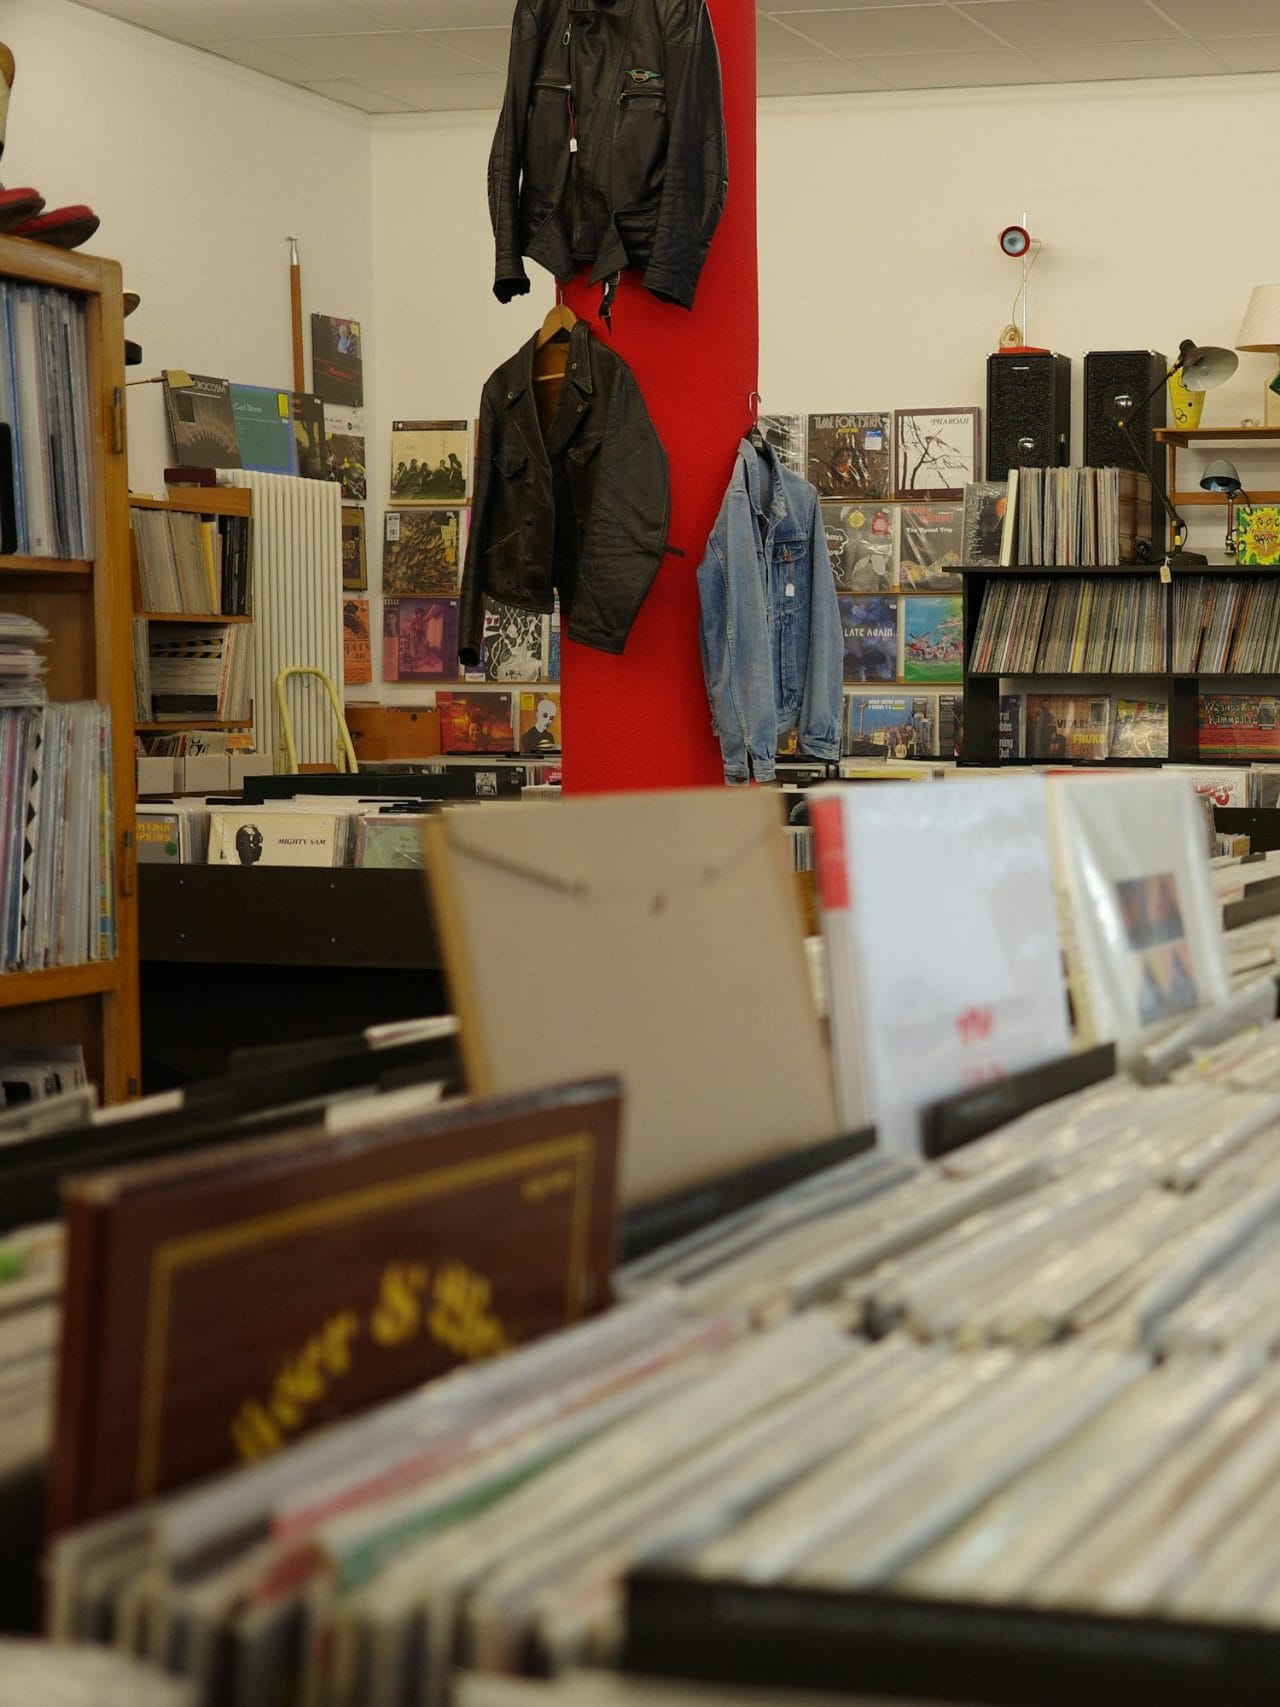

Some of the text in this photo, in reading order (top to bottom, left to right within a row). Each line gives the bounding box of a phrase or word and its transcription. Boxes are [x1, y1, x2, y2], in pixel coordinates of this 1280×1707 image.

[834, 415, 856, 429] FOR
[843, 627, 894, 638] LATE AGAIN
[278, 838, 326, 846] MIGHTY SAM
